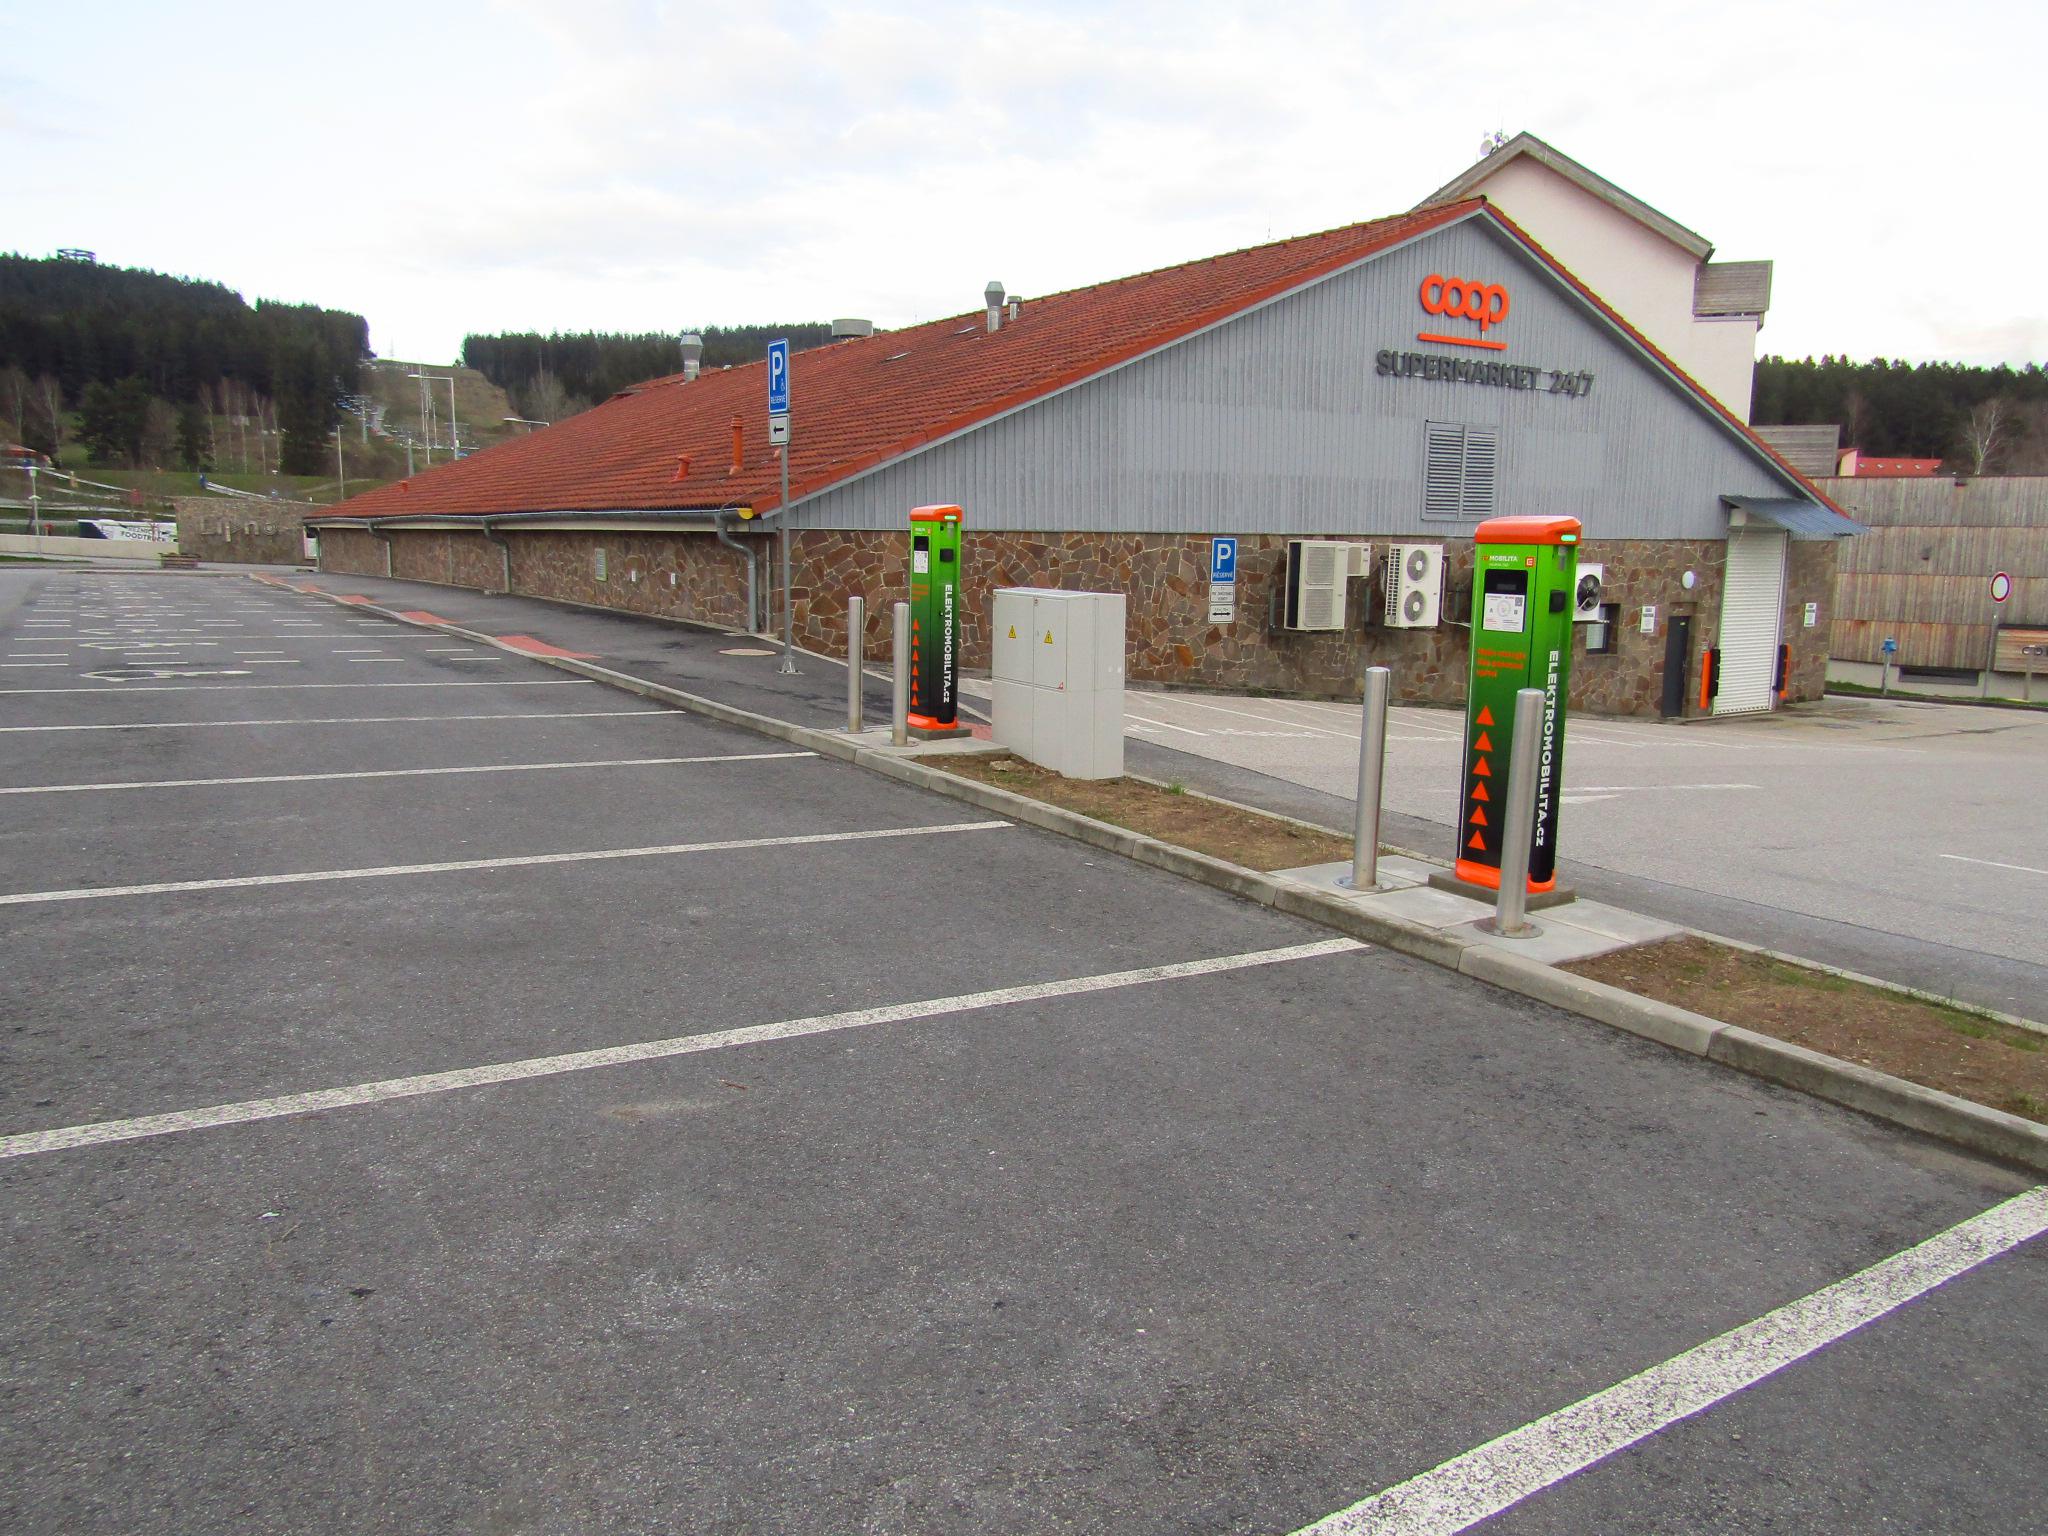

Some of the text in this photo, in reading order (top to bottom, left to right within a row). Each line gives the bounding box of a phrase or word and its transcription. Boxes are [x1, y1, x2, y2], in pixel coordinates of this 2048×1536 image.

[1421, 274, 1510, 331] coop
[772, 351, 783, 390] P
[1376, 349, 1595, 399] SUPERMARKET 24/7
[1217, 544, 1231, 569] P
[1535, 651, 1559, 847] ELEKTROMOBILITA.cz
